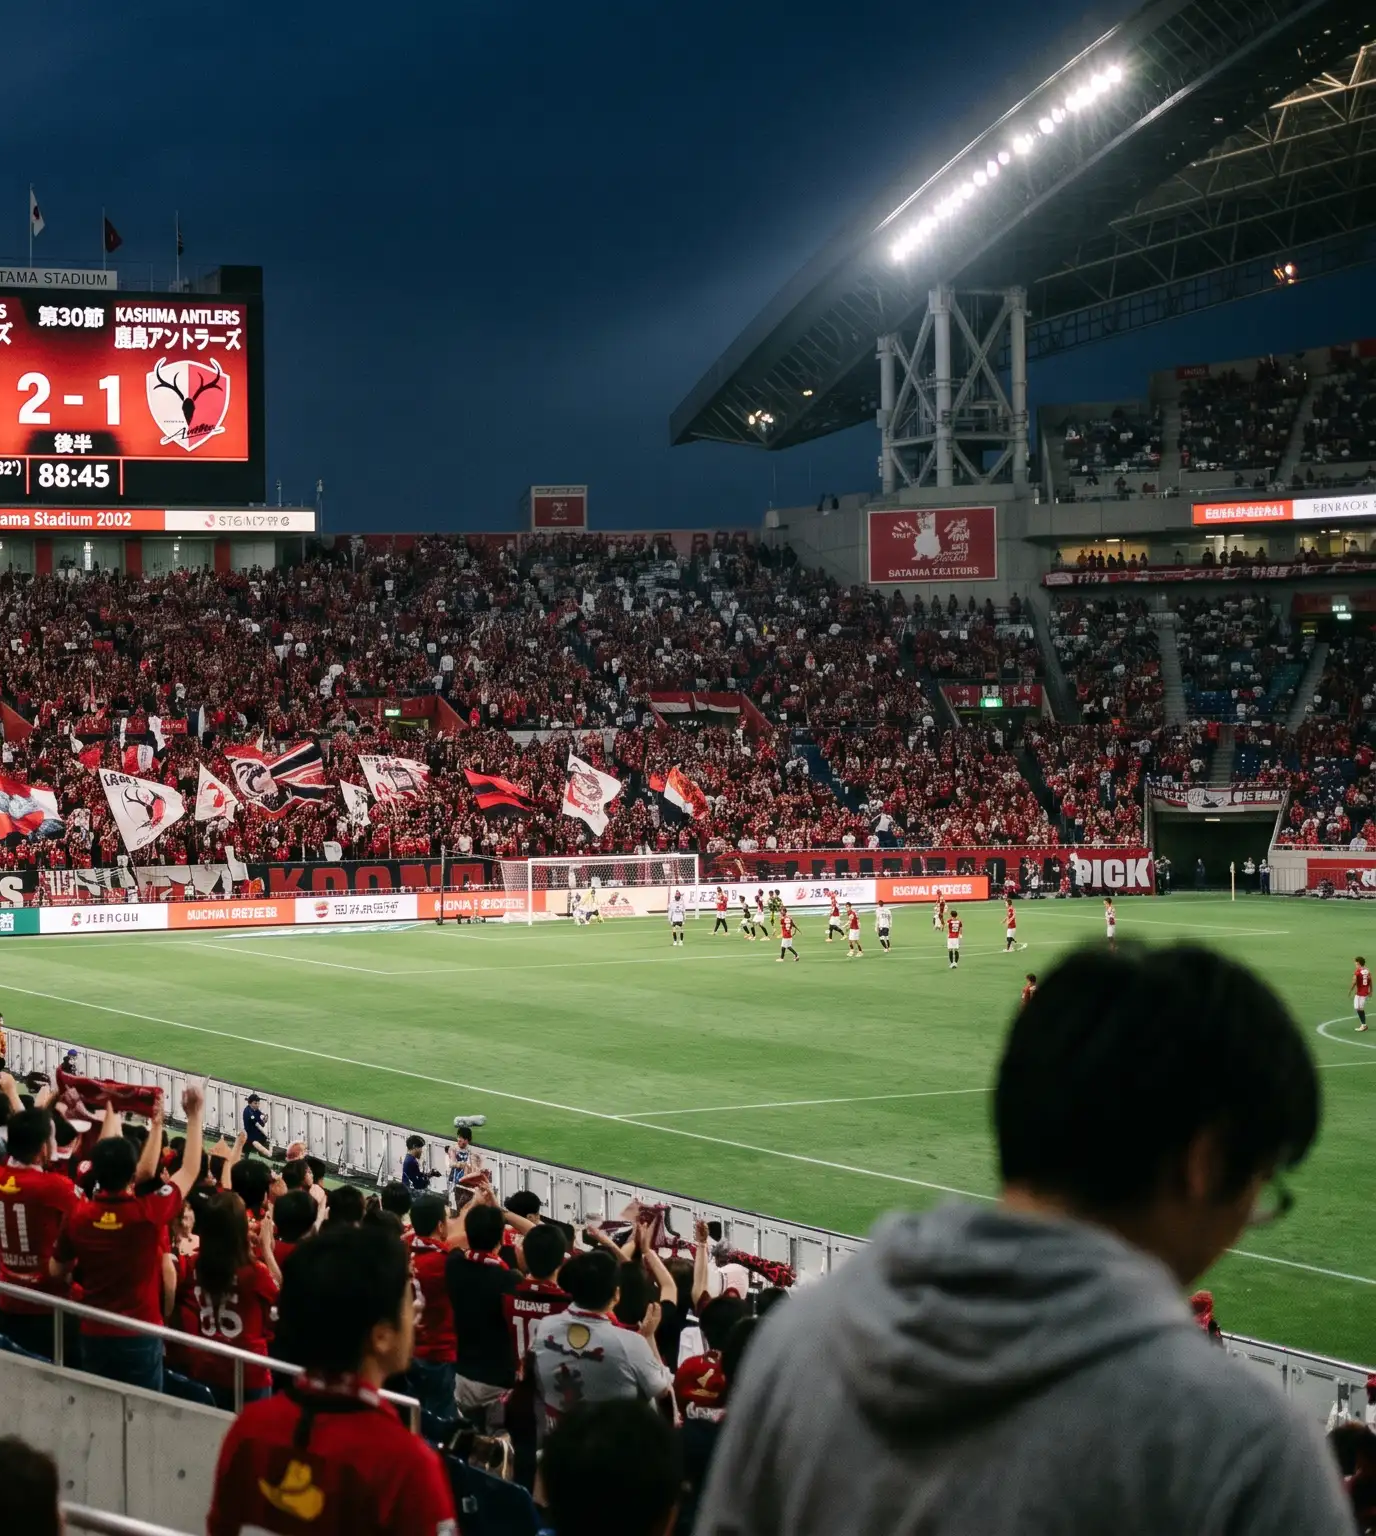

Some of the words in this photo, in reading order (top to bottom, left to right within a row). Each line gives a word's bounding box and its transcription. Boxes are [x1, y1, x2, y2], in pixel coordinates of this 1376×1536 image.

[44, 272, 108, 286] STADIUM
[38, 305, 104, 328] 第30節
[115, 307, 177, 324] KASHIMA
[179, 309, 240, 325] ANTLERS
[17, 371, 51, 424] 2
[99, 375, 120, 425] 1
[54, 433, 93, 453] 後半
[38, 463, 110, 488] 88:45
[34, 511, 92, 526] Stadium
[96, 512, 132, 527] 2002
